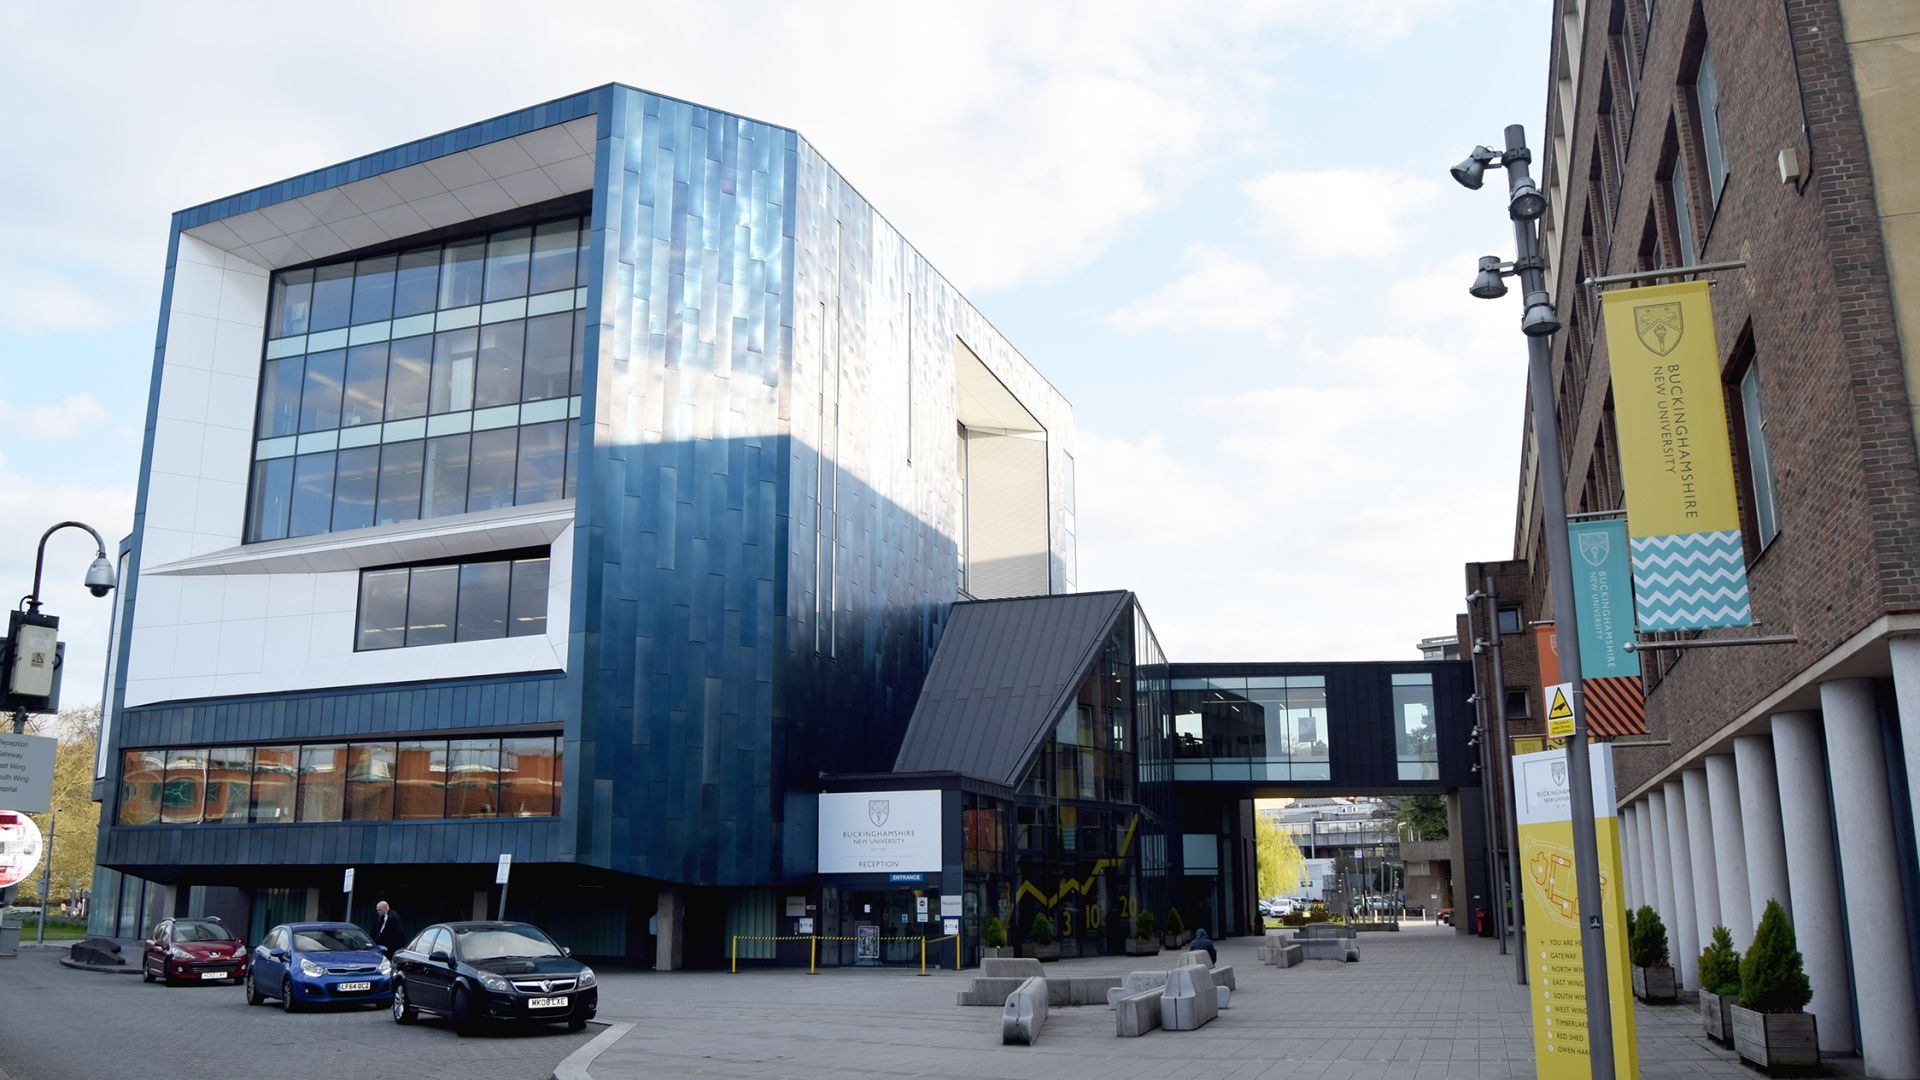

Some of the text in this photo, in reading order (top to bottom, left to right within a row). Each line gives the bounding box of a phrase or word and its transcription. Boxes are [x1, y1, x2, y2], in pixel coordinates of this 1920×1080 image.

[1653, 366, 1677, 474] NEW UNIVERSITY
[1667, 364, 1698, 519] BUCKINGHAMSHIRE
[1589, 571, 1604, 640] NEW UNIVERSITY
[1598, 570, 1616, 669] BUCKINGHAMSHIRE
[842, 830, 916, 839] BUCKINGHAMSHIRE
[858, 860, 899, 868] RECEPTION
[1119, 895, 1138, 918] 20
[1085, 903, 1101, 929] 10
[1061, 910, 1073, 937] 3
[1563, 939, 1574, 947] ARE
[1550, 952, 1576, 960] GATEWAY
[1567, 980, 1584, 988] WING
[1553, 992, 1573, 1000] SOUTH
[1556, 1032, 1584, 1042] RED SHED
[1557, 1046, 1576, 1054] OWEN
